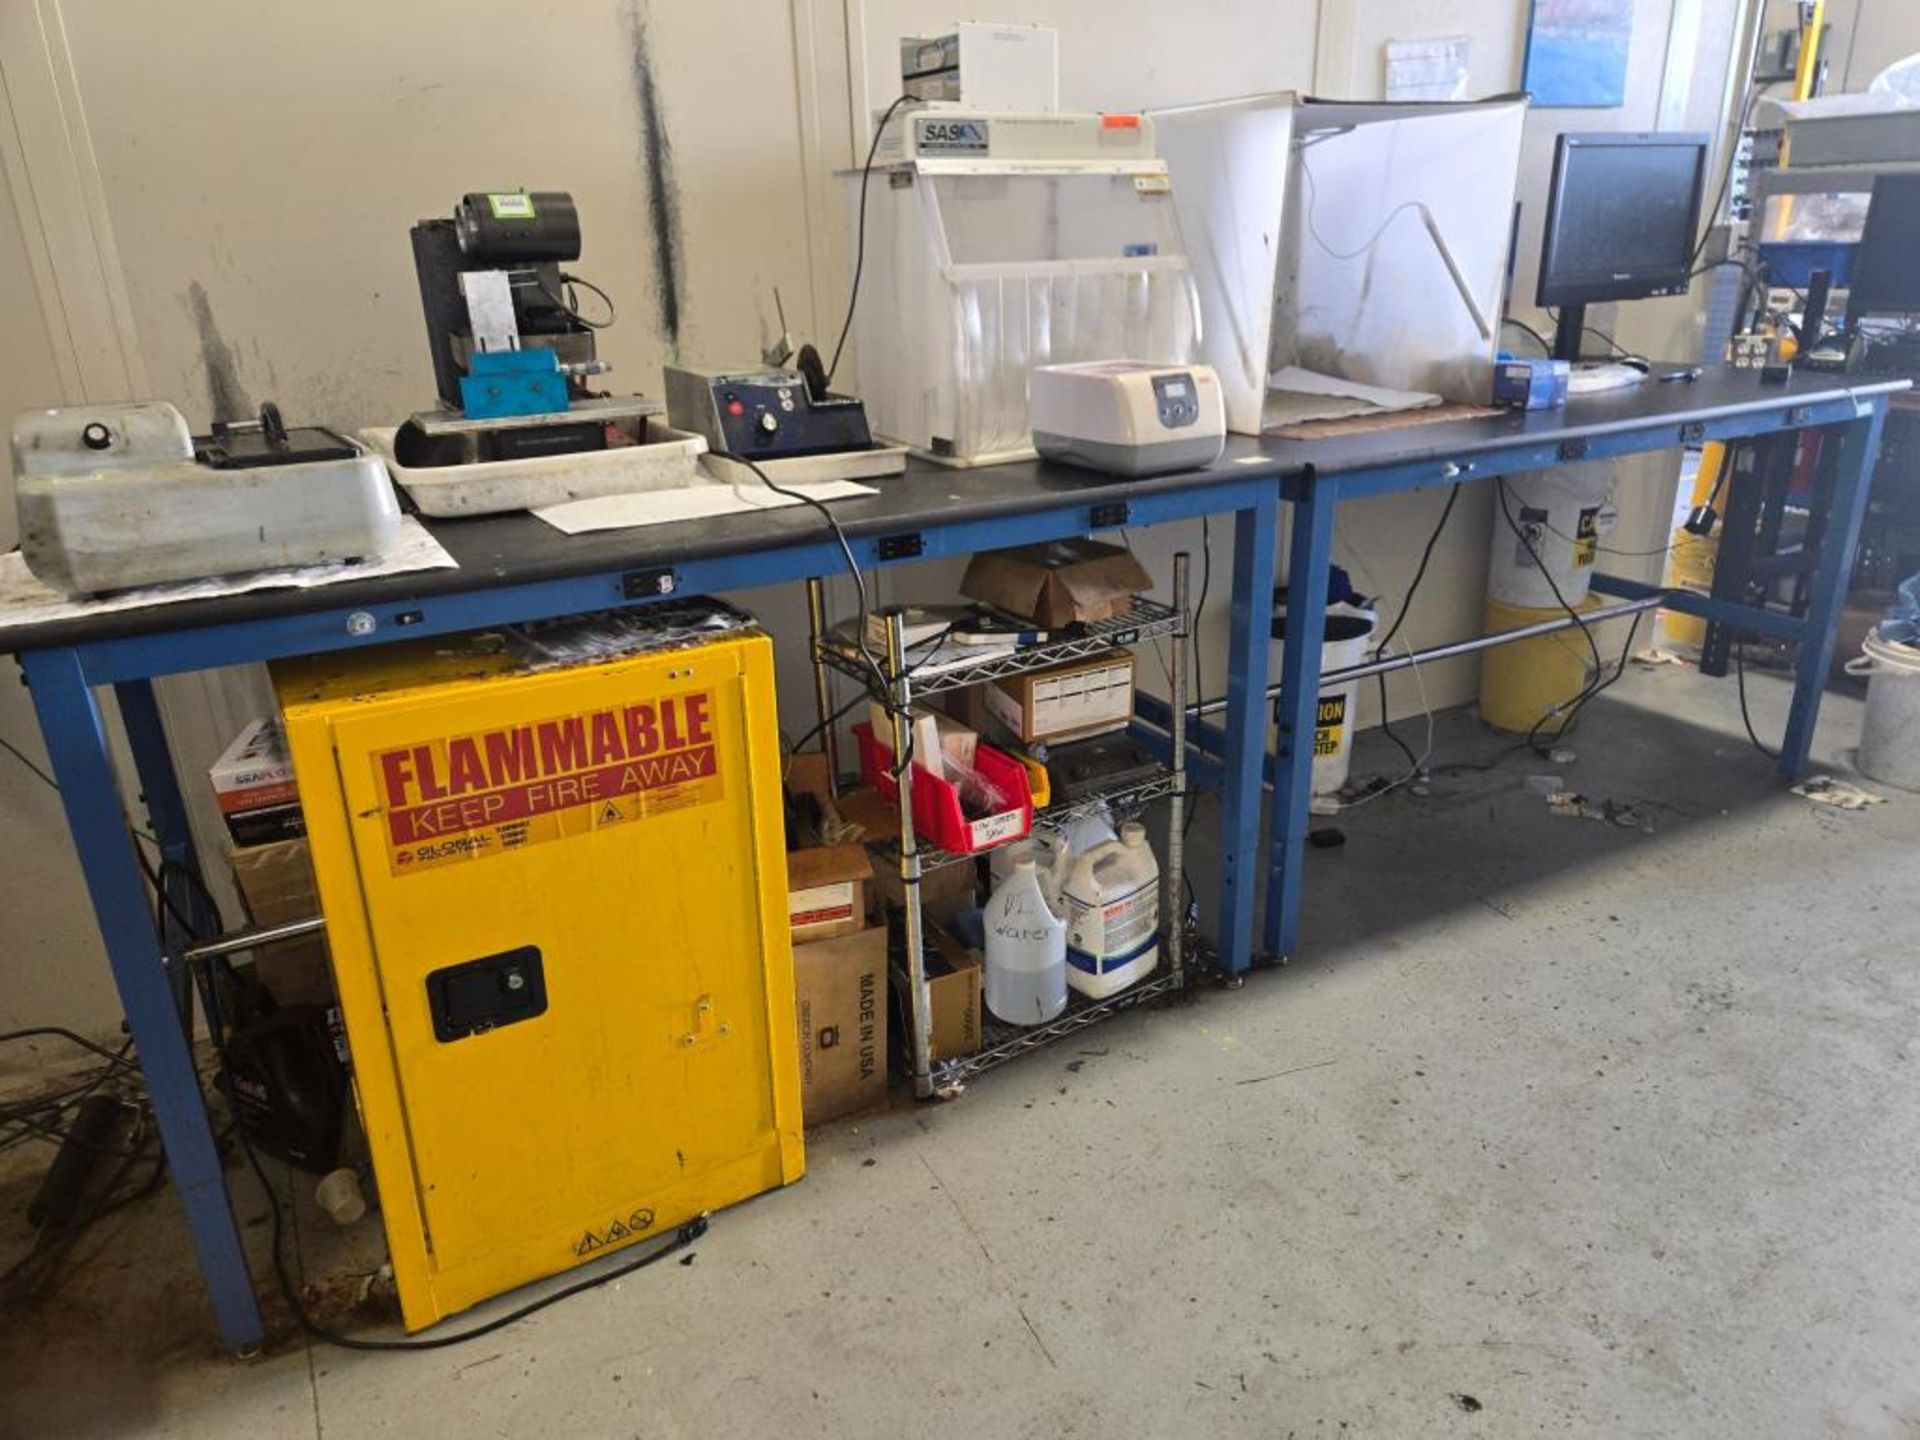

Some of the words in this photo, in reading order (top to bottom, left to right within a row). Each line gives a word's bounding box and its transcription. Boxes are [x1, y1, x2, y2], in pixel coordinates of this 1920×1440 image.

[381, 693, 713, 807] FLAMMABLE
[409, 795, 504, 838] KEEP
[529, 773, 602, 811] FIRE
[620, 750, 707, 792] AWAY
[858, 973, 875, 1021] MADE
[858, 1024, 874, 1042] IN
[858, 1045, 875, 1081] USA
